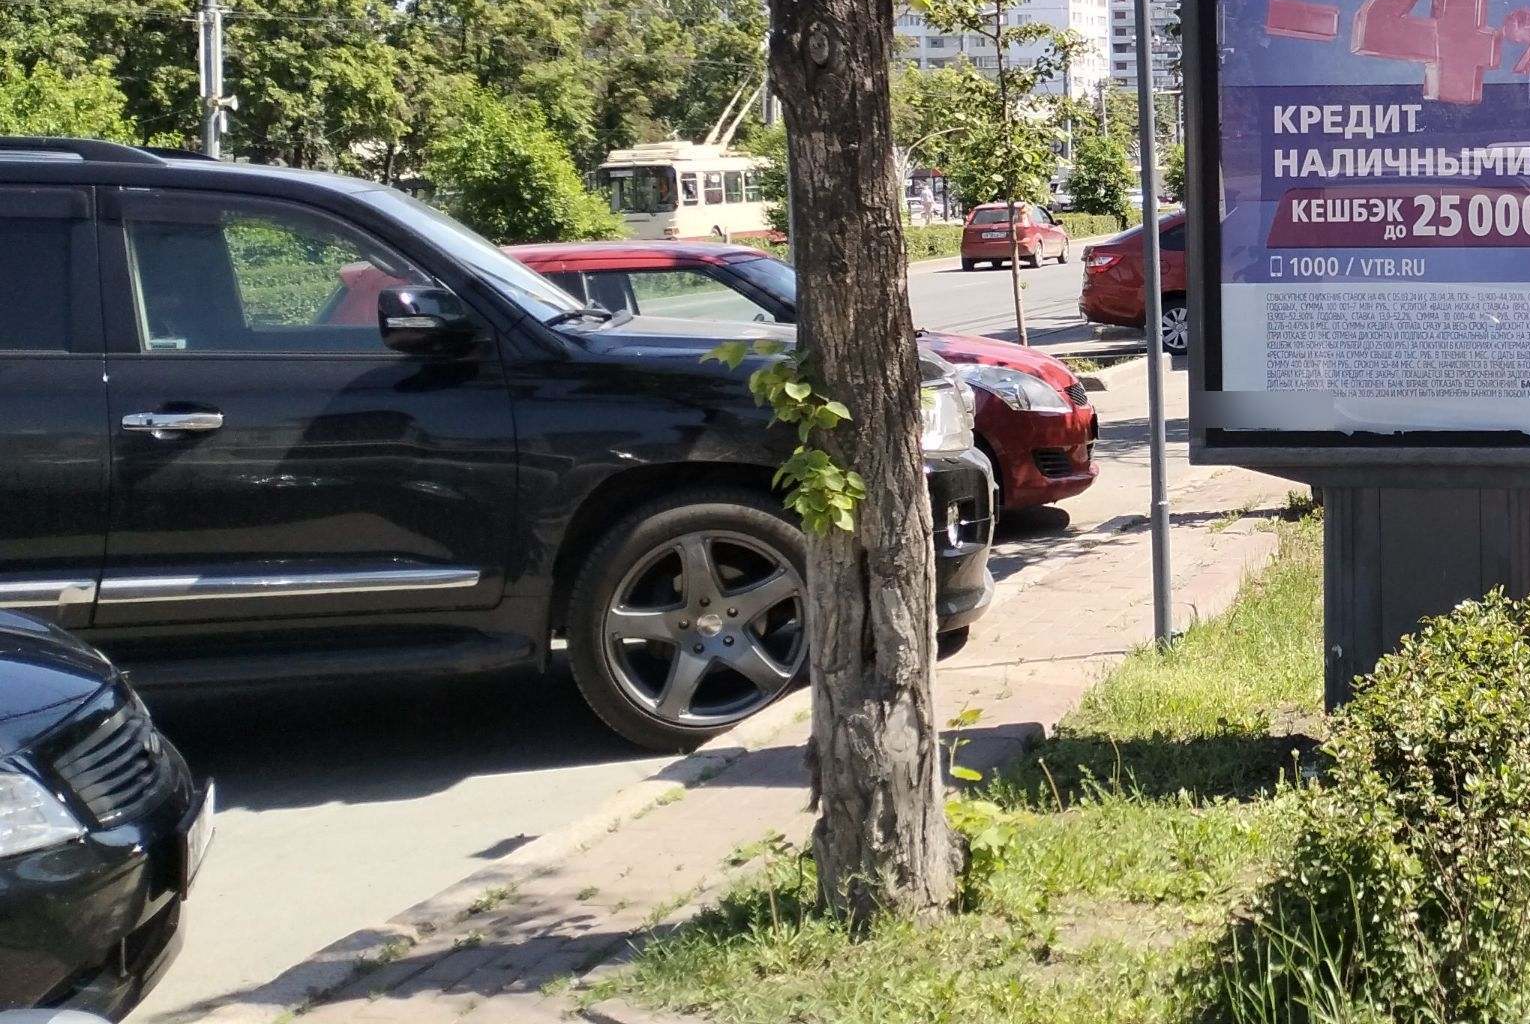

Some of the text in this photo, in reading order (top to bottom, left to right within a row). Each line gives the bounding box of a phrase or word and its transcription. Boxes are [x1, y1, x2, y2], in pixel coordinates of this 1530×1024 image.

[1274, 105, 1422, 139] КРЕДИТ
[1274, 148, 1530, 177] НАЛИЧНЫМИ
[1292, 199, 1404, 222] КЕШБЭК
[1289, 257, 1339, 276] 1000
[1360, 258, 1425, 276] VTB.RU
